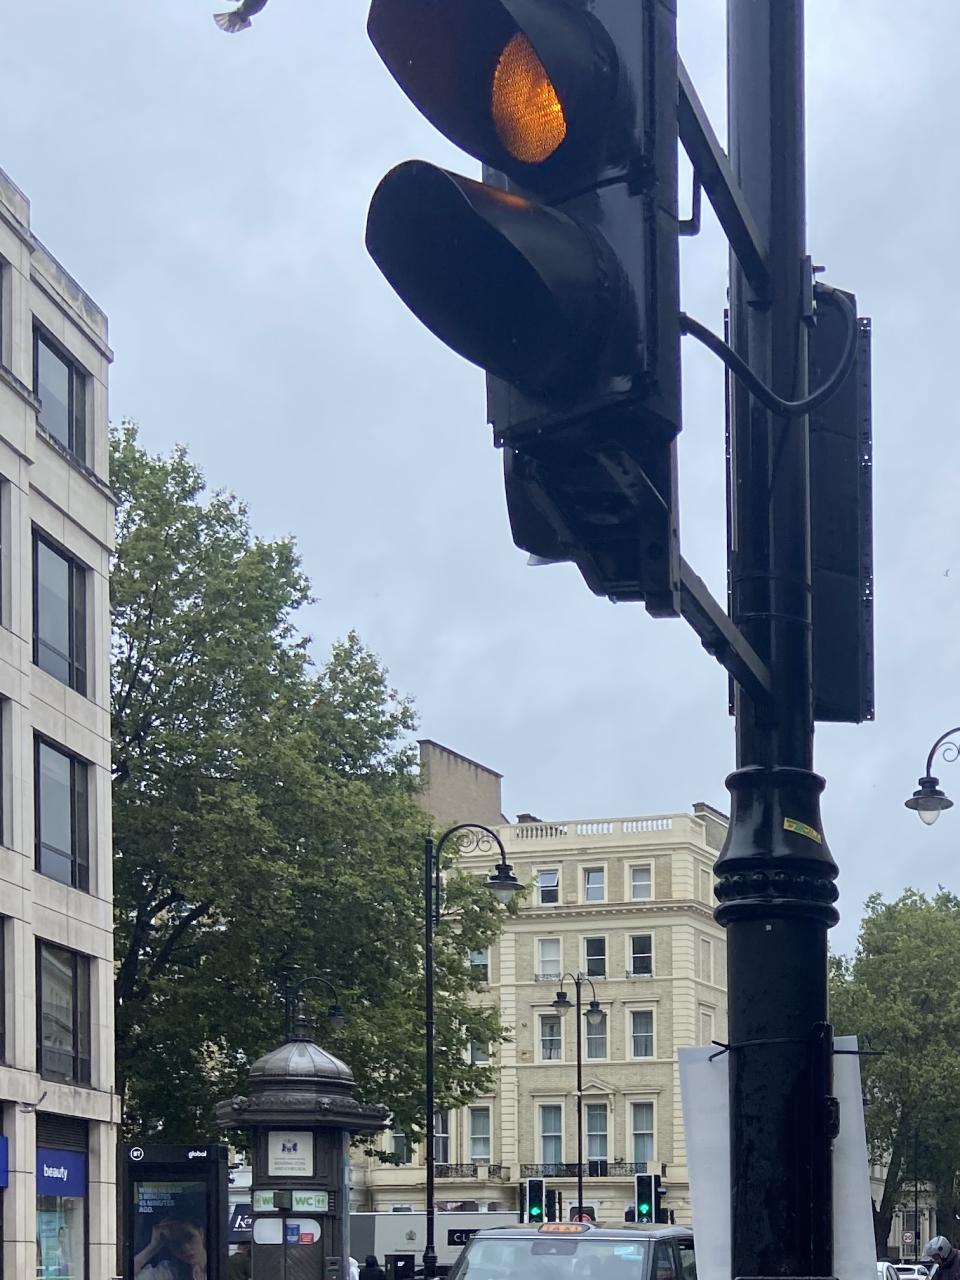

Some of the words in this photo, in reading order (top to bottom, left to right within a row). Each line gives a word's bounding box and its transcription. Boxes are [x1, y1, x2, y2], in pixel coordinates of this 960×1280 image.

[188, 1150, 207, 1159] global
[43, 1163, 68, 1182] beauty
[295, 1196, 315, 1206] WC
